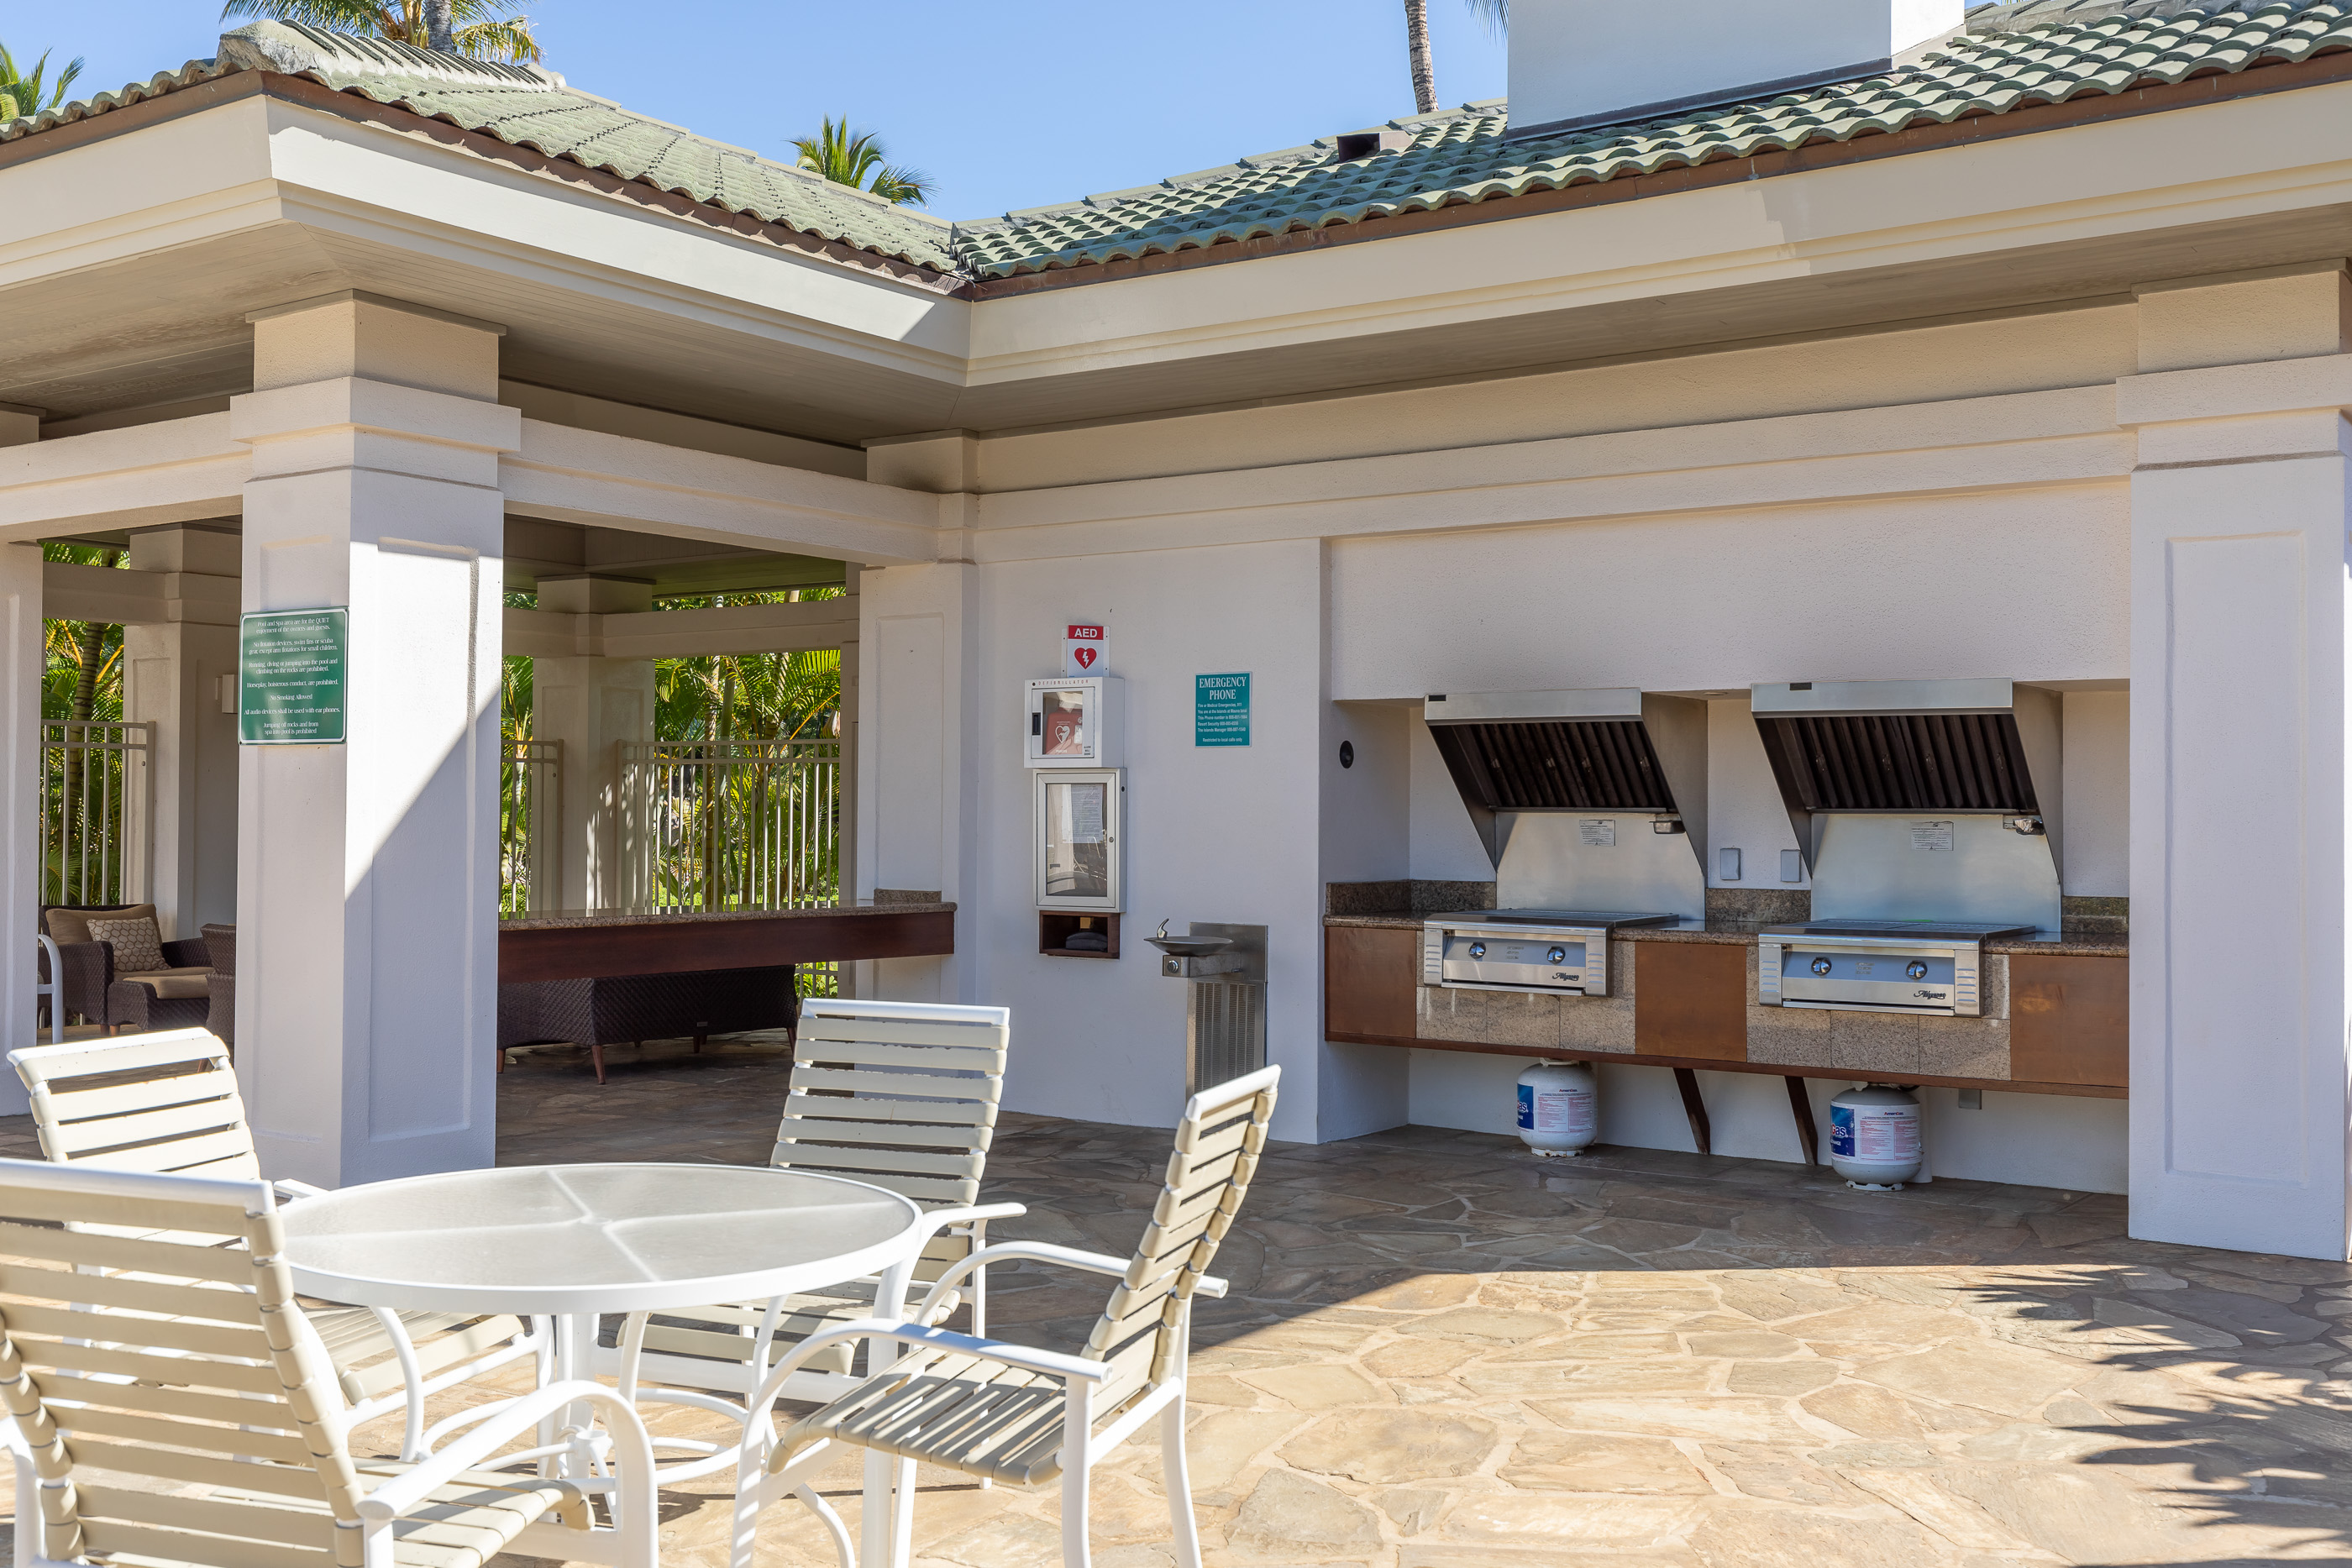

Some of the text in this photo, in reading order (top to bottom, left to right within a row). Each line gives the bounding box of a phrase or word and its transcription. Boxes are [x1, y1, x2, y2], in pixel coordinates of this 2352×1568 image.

[1074, 628, 1097, 638] AED
[1199, 677, 1246, 688] EMERGENCY
[1209, 689, 1236, 700] PHONE
